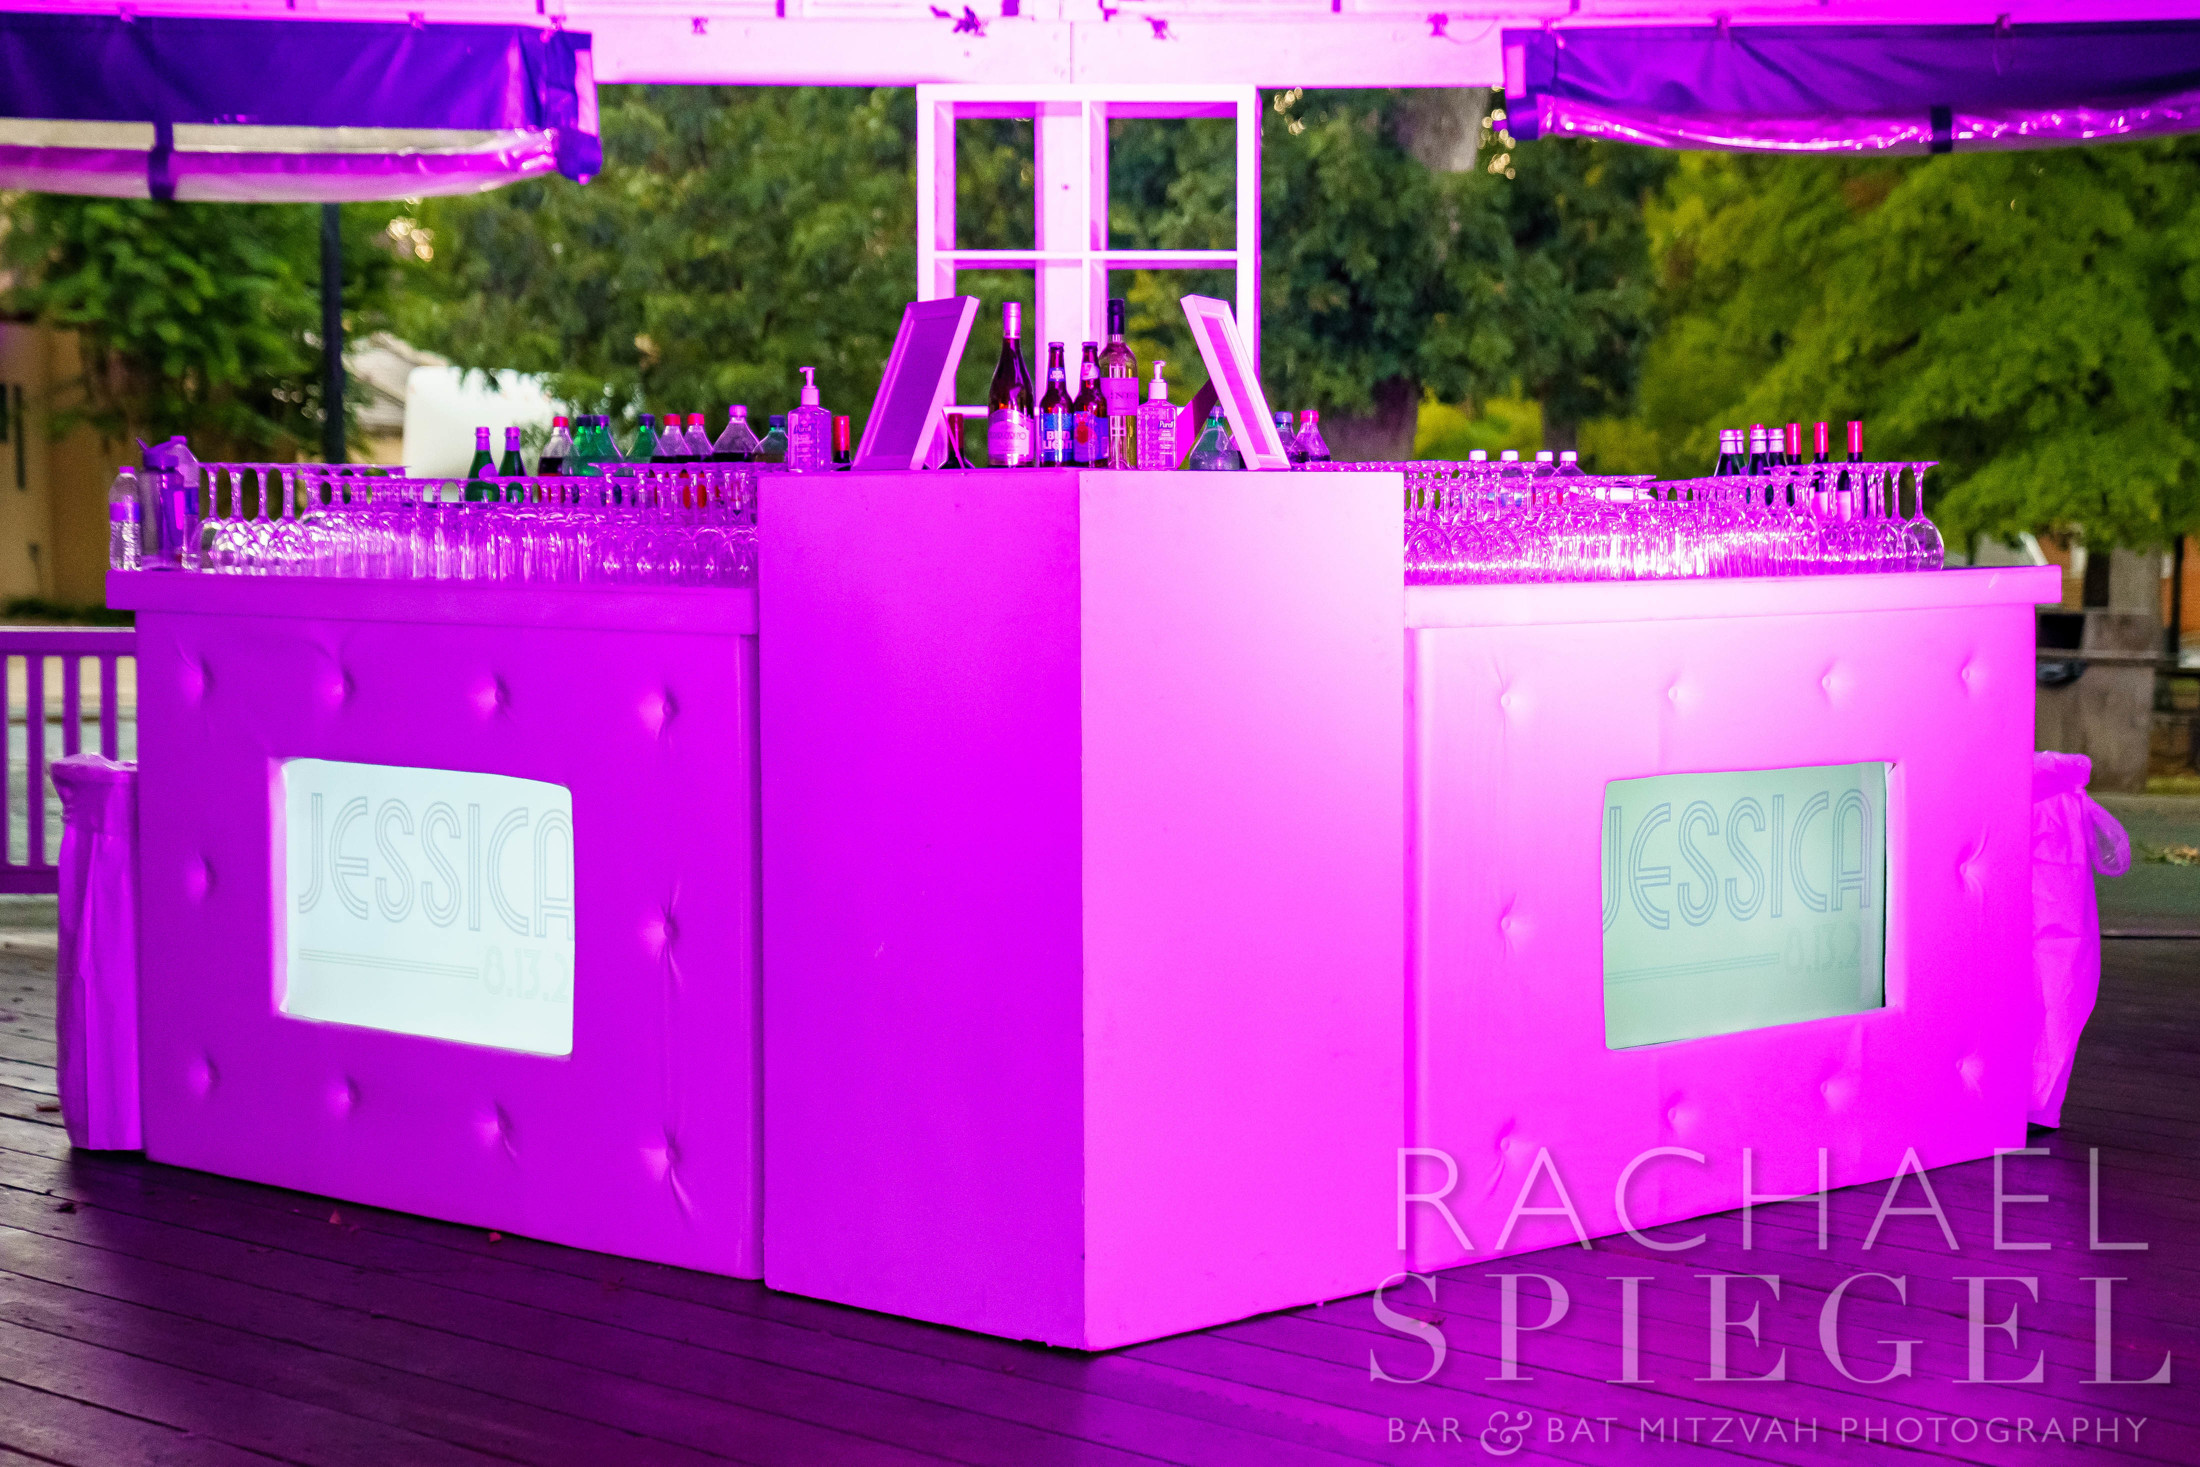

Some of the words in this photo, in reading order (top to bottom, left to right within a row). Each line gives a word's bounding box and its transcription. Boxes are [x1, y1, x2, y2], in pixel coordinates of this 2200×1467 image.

[1043, 439, 1073, 450] LIGHT
[1046, 430, 1071, 440] BUD
[298, 792, 575, 942] JESSICA
[1602, 788, 1872, 933] JESSICA
